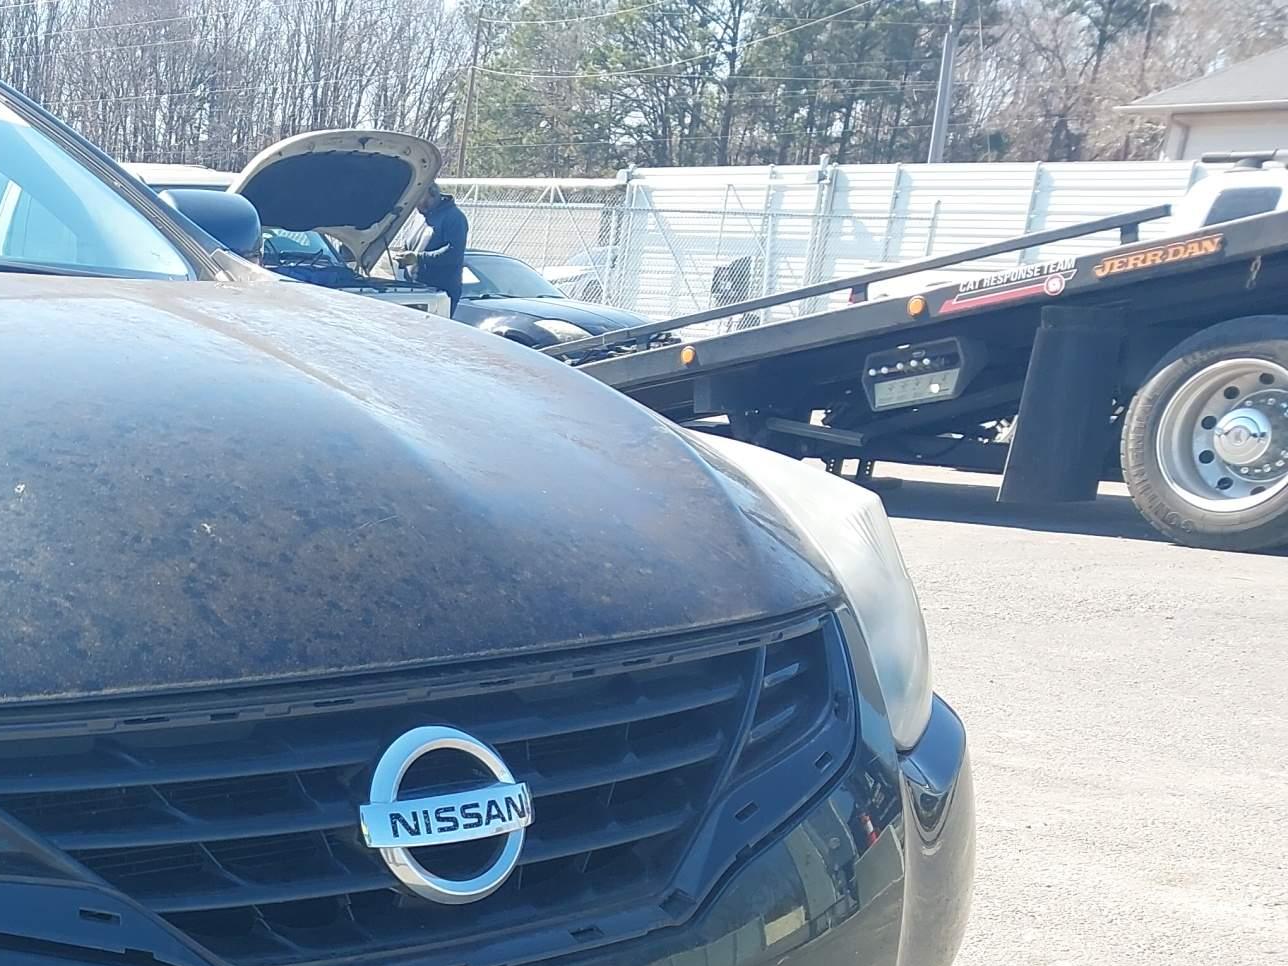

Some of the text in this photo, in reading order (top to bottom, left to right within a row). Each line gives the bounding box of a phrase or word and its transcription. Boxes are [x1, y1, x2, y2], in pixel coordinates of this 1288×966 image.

[958, 257, 1077, 293] CAT RESPONSE TEAM
[388, 792, 526, 839] NISSAN
